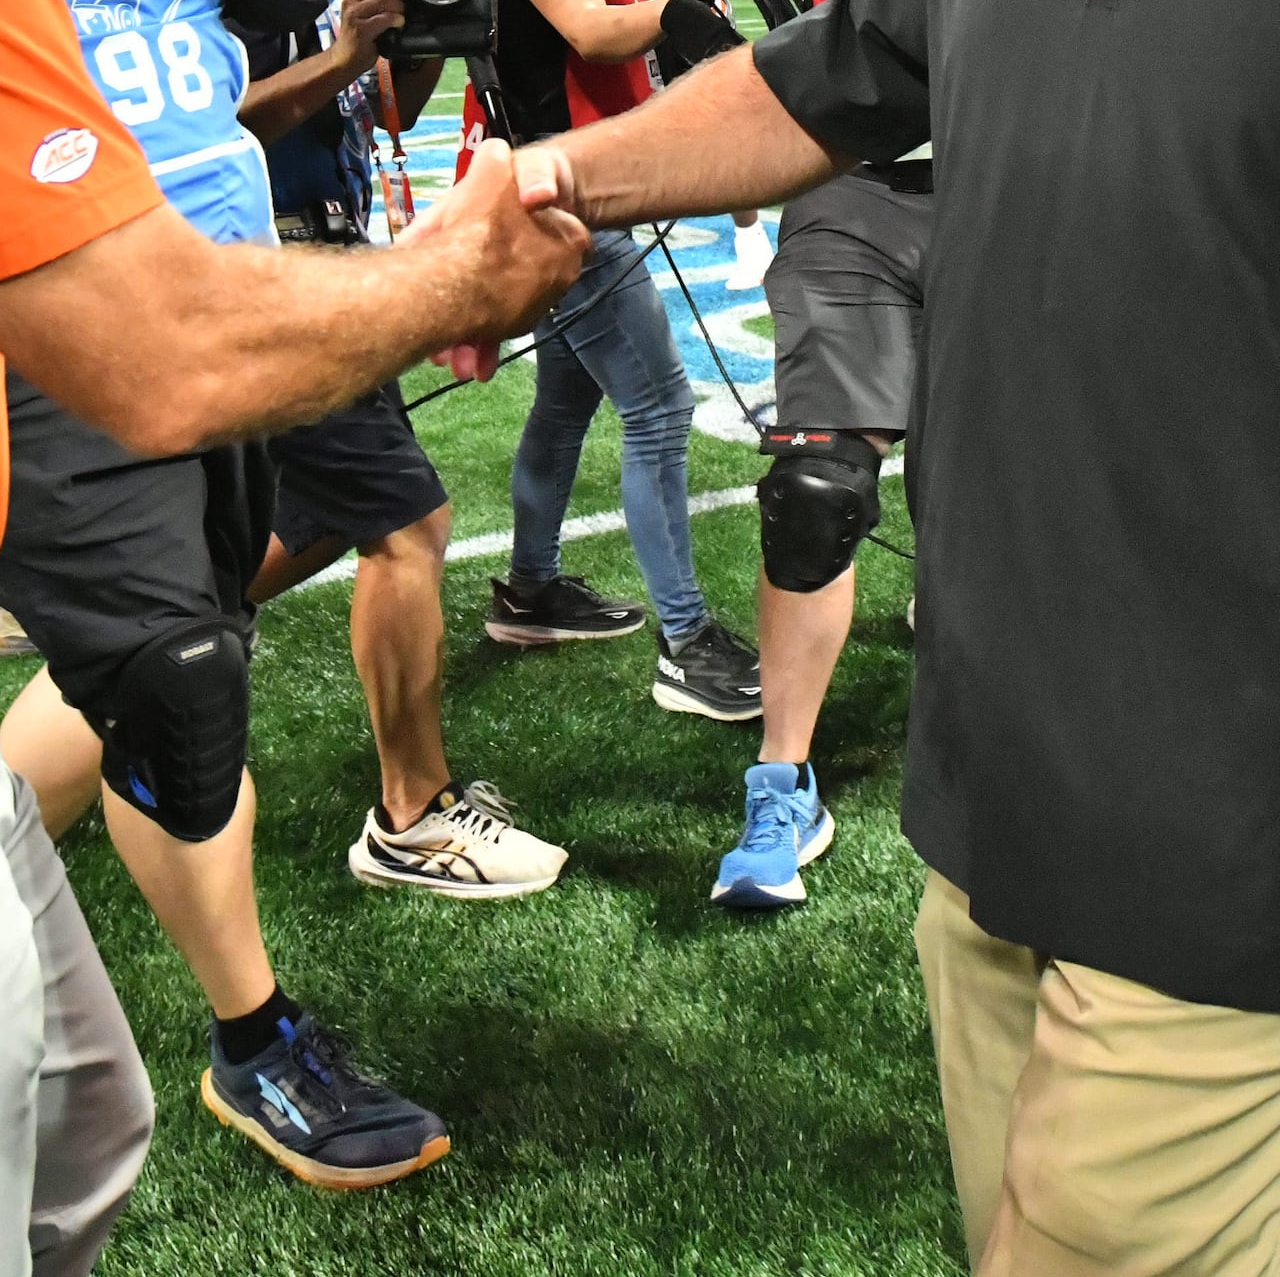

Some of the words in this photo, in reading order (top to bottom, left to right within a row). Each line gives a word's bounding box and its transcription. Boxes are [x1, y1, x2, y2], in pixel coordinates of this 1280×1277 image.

[93, 21, 215, 127] 98
[45, 133, 88, 172] ACC
[658, 654, 686, 683] HOKA
